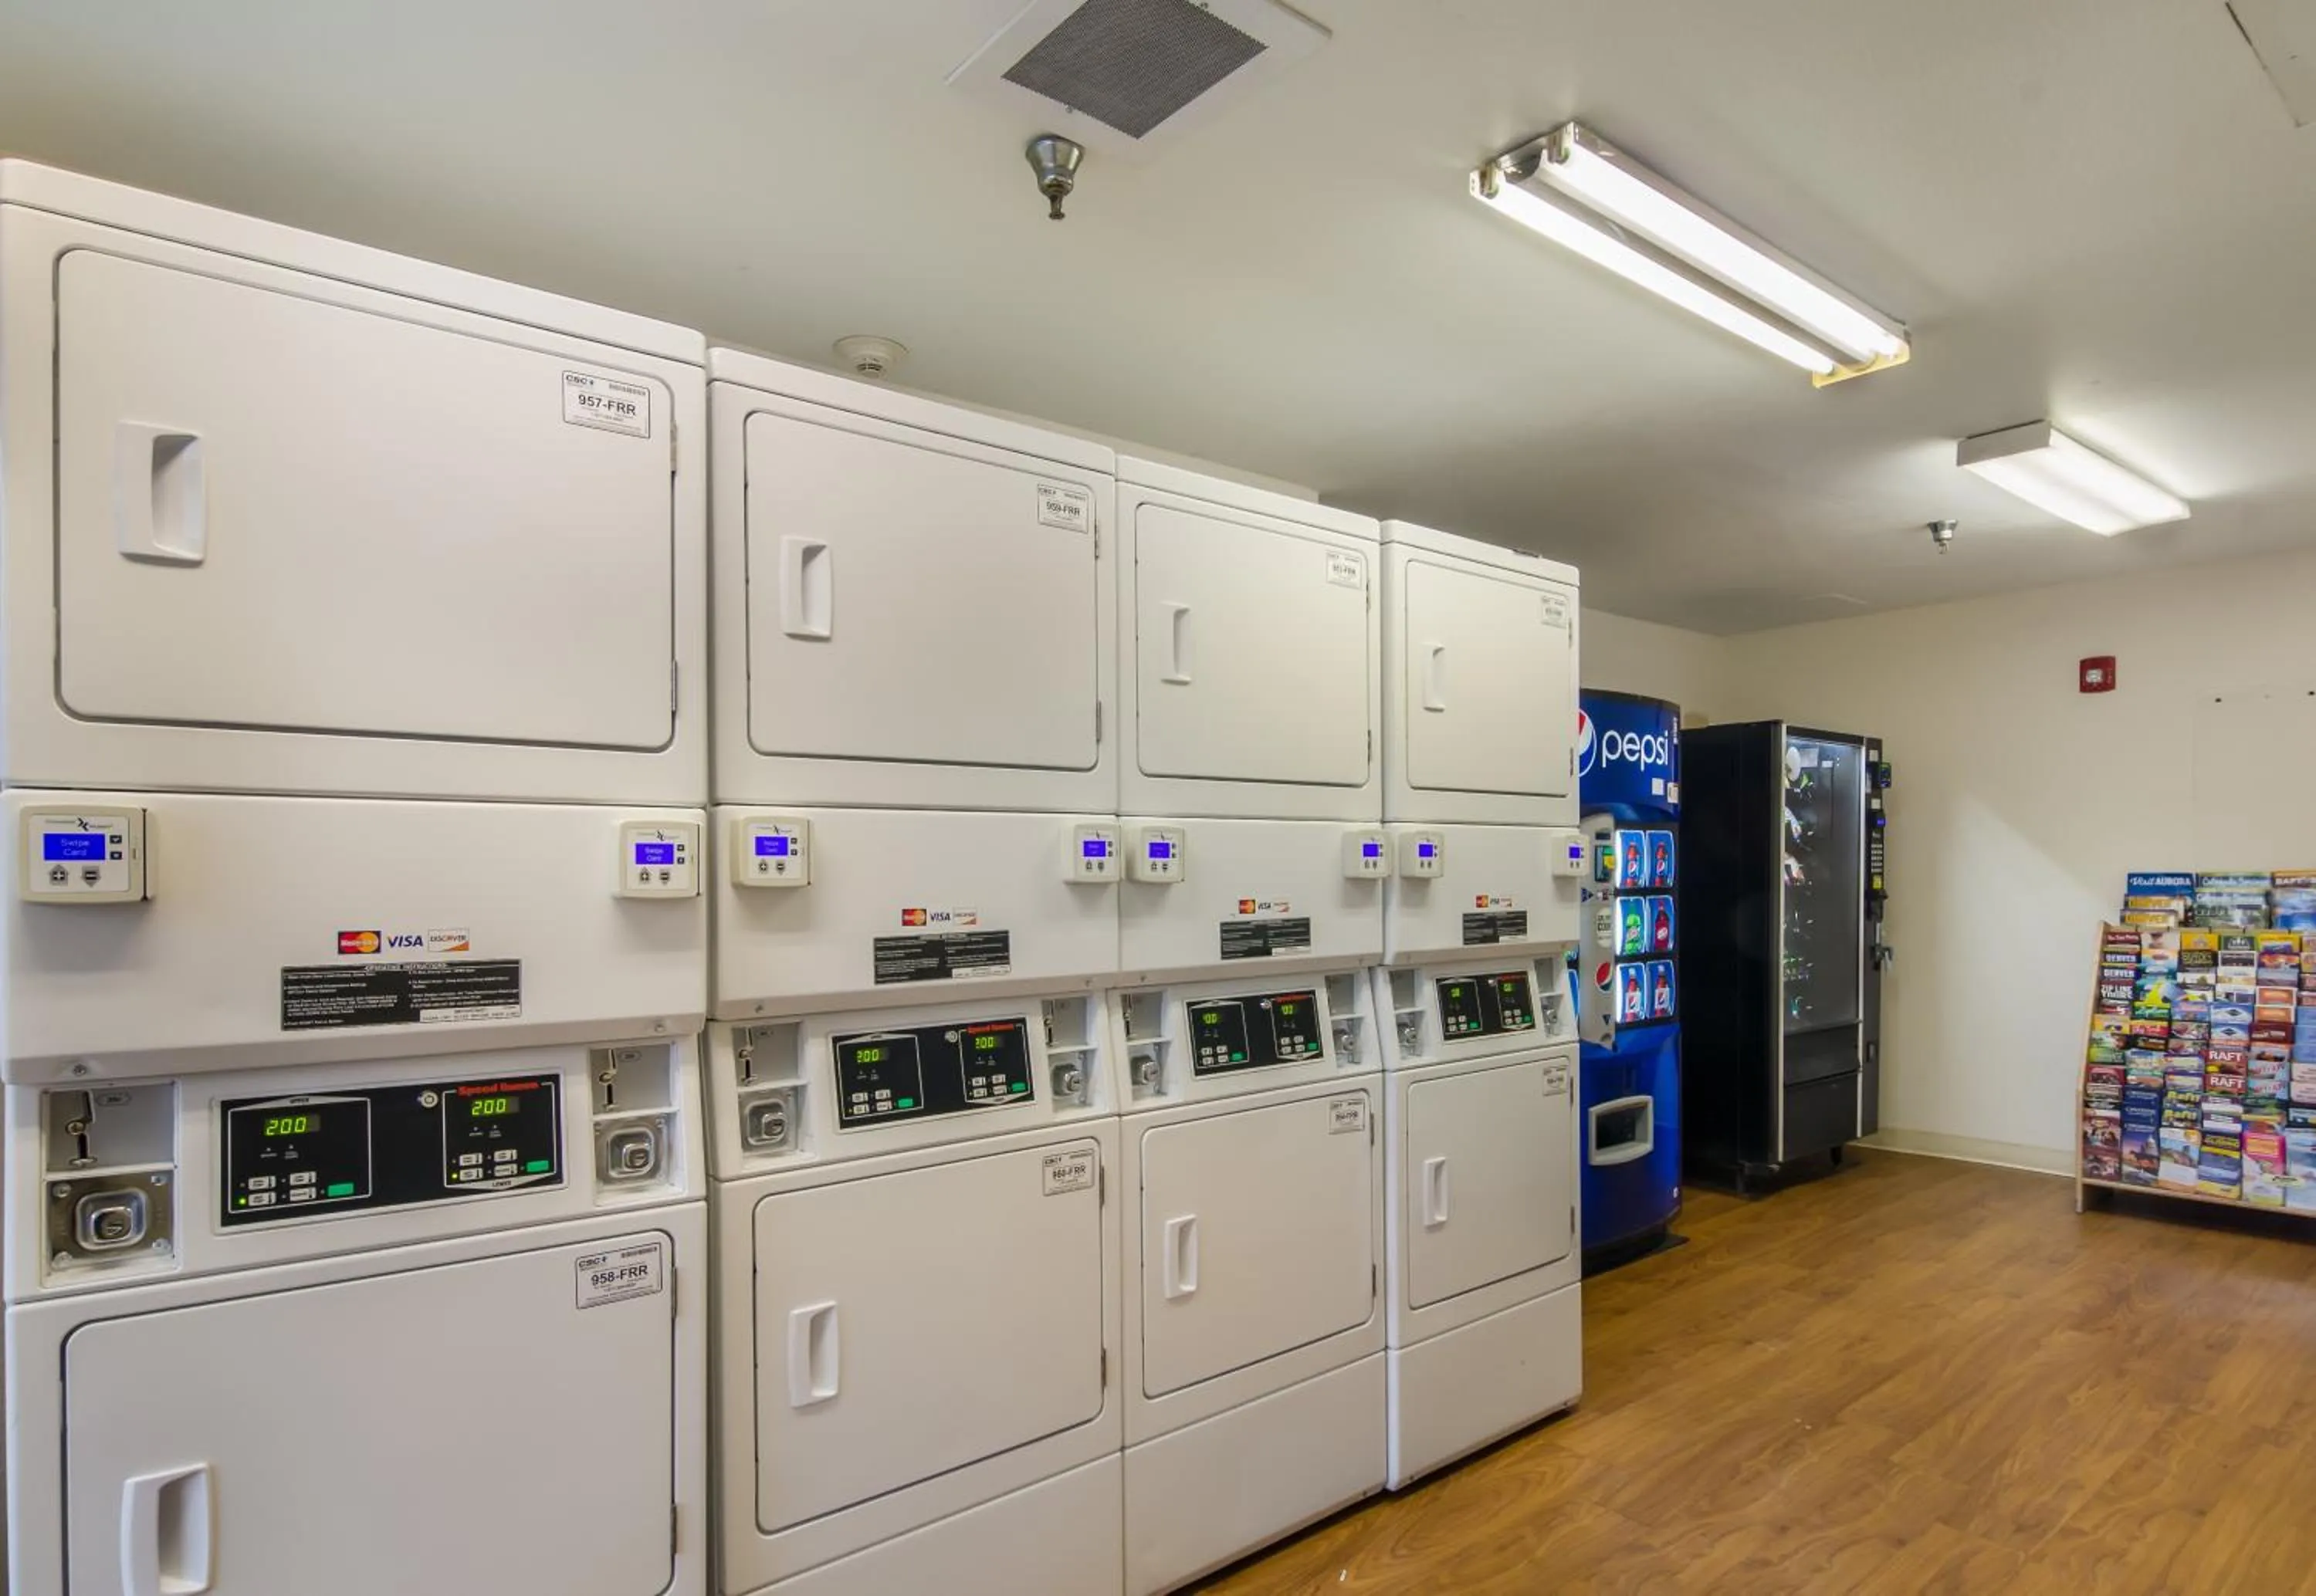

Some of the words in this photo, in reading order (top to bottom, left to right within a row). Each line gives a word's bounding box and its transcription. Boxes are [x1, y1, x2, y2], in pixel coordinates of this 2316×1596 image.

[578, 394, 636, 416] 957-FRR
[1602, 729, 1668, 772] pepsi
[61, 839, 90, 847] Swipe
[930, 911, 951, 922] VISA
[388, 935, 424, 948] VISA
[2209, 1050, 2243, 1061] RAFT
[2210, 1076, 2246, 1089] RAFT
[472, 1098, 506, 1115] 200
[266, 1117, 306, 1136] 200
[591, 1265, 648, 1287] 958-FRR
